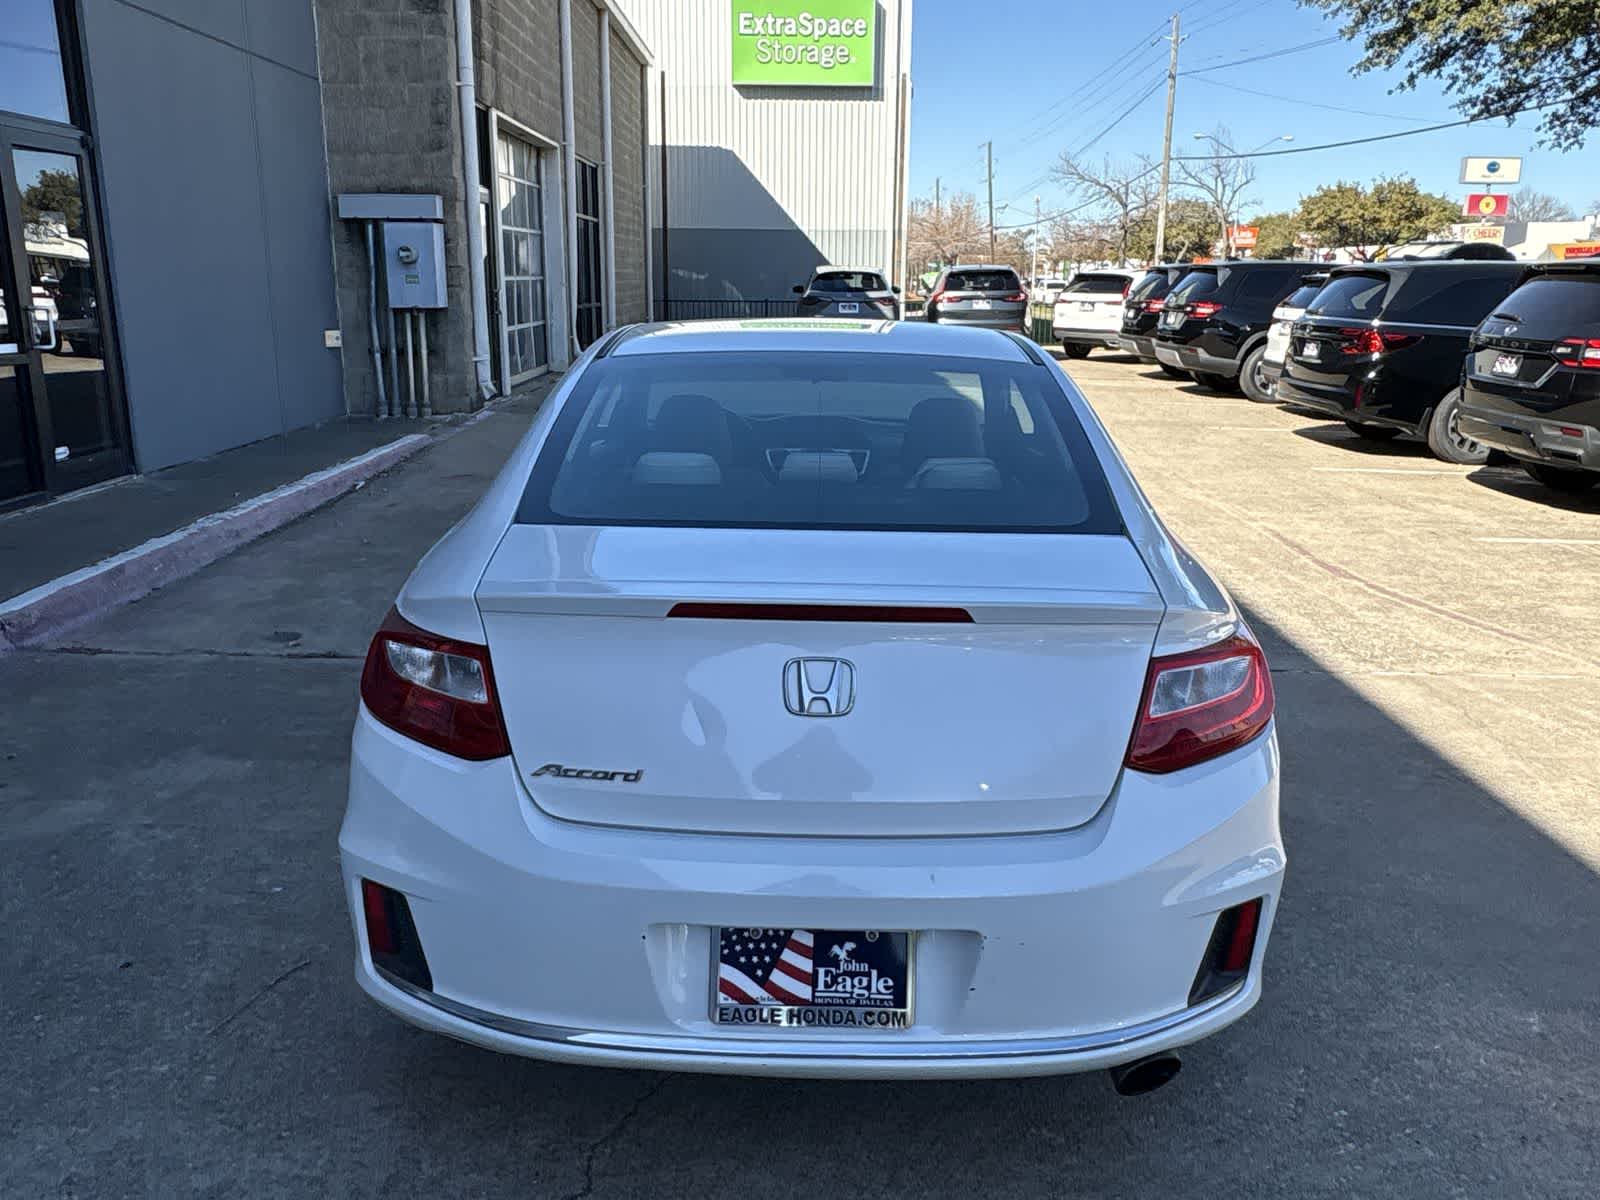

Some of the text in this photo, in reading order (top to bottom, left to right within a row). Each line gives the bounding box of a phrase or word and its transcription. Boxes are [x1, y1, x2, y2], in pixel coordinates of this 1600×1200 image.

[530, 763, 644, 783] Accord
[836, 959, 869, 974] John
[815, 967, 894, 999] Eagle
